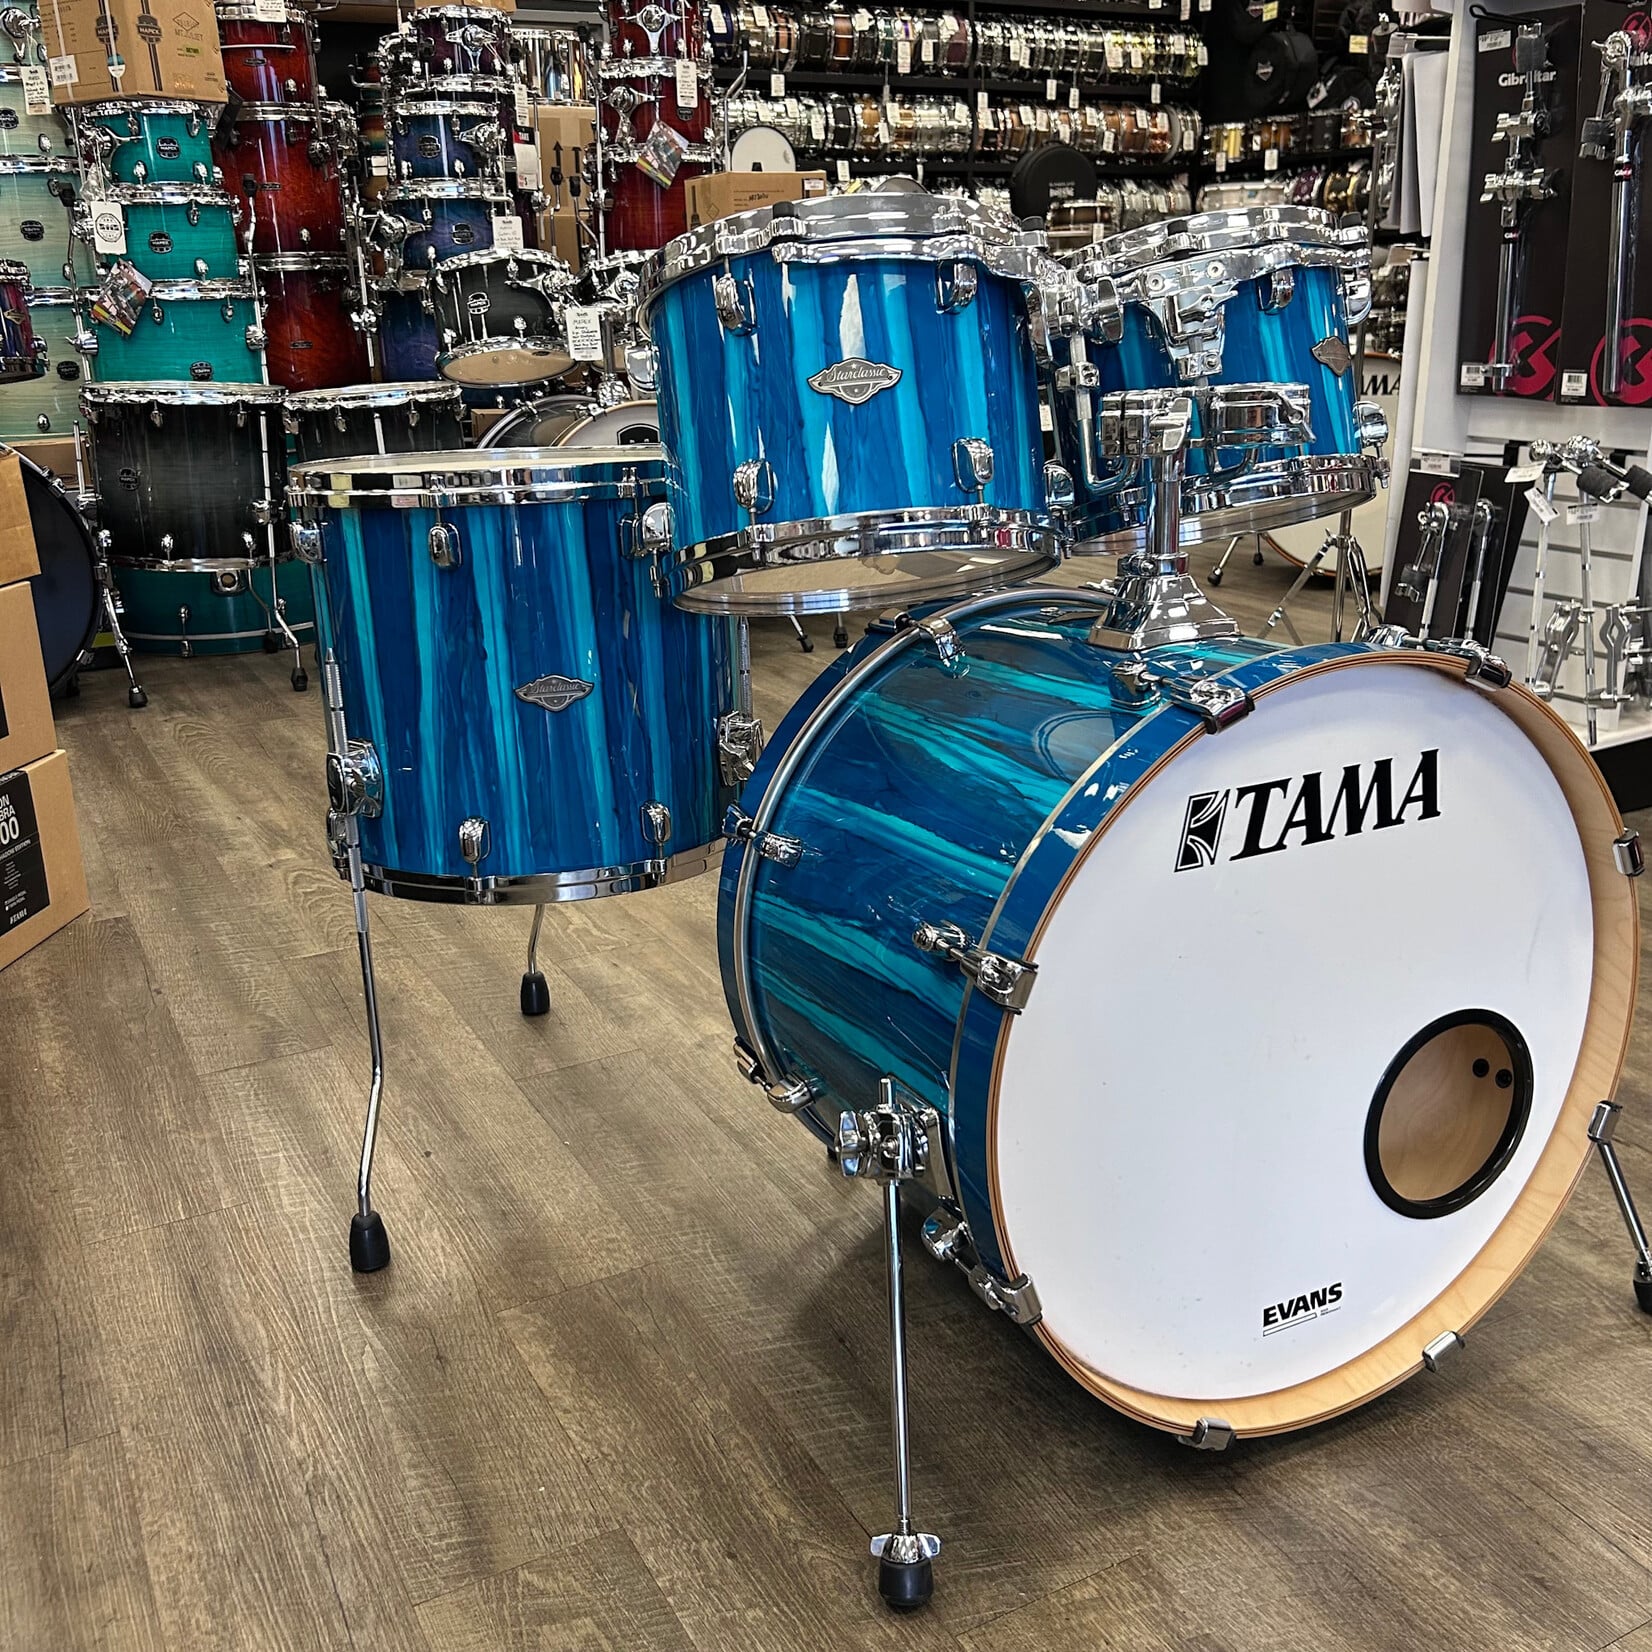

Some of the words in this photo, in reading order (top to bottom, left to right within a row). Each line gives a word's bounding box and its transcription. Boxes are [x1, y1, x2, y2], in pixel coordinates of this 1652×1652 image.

[97, 26, 118, 35] MAPX
[139, 26, 161, 35] MAPEX
[1498, 70, 1557, 87] Gibrltar
[826, 366, 886, 383] Starclassic
[1360, 373, 1401, 396] MA
[530, 681, 580, 694] Starclassic
[1229, 748, 1441, 861] TAMA
[1263, 1281, 1343, 1328] EVANS
